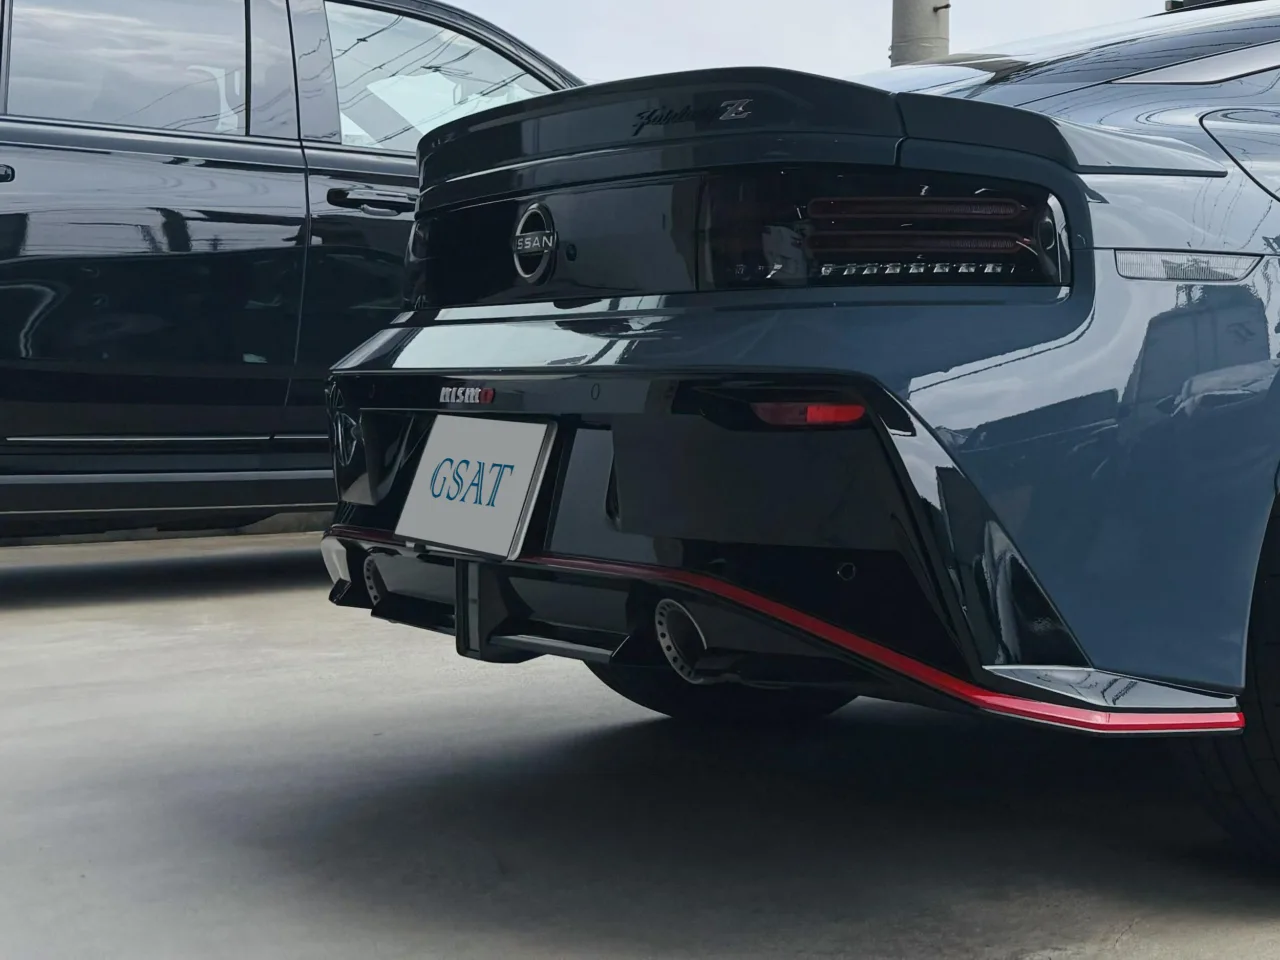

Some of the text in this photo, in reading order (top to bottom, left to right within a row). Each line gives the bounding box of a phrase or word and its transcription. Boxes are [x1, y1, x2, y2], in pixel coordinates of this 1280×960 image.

[719, 98, 753, 121] Z
[515, 235, 553, 250] SSAN
[429, 457, 515, 507] GSAT
